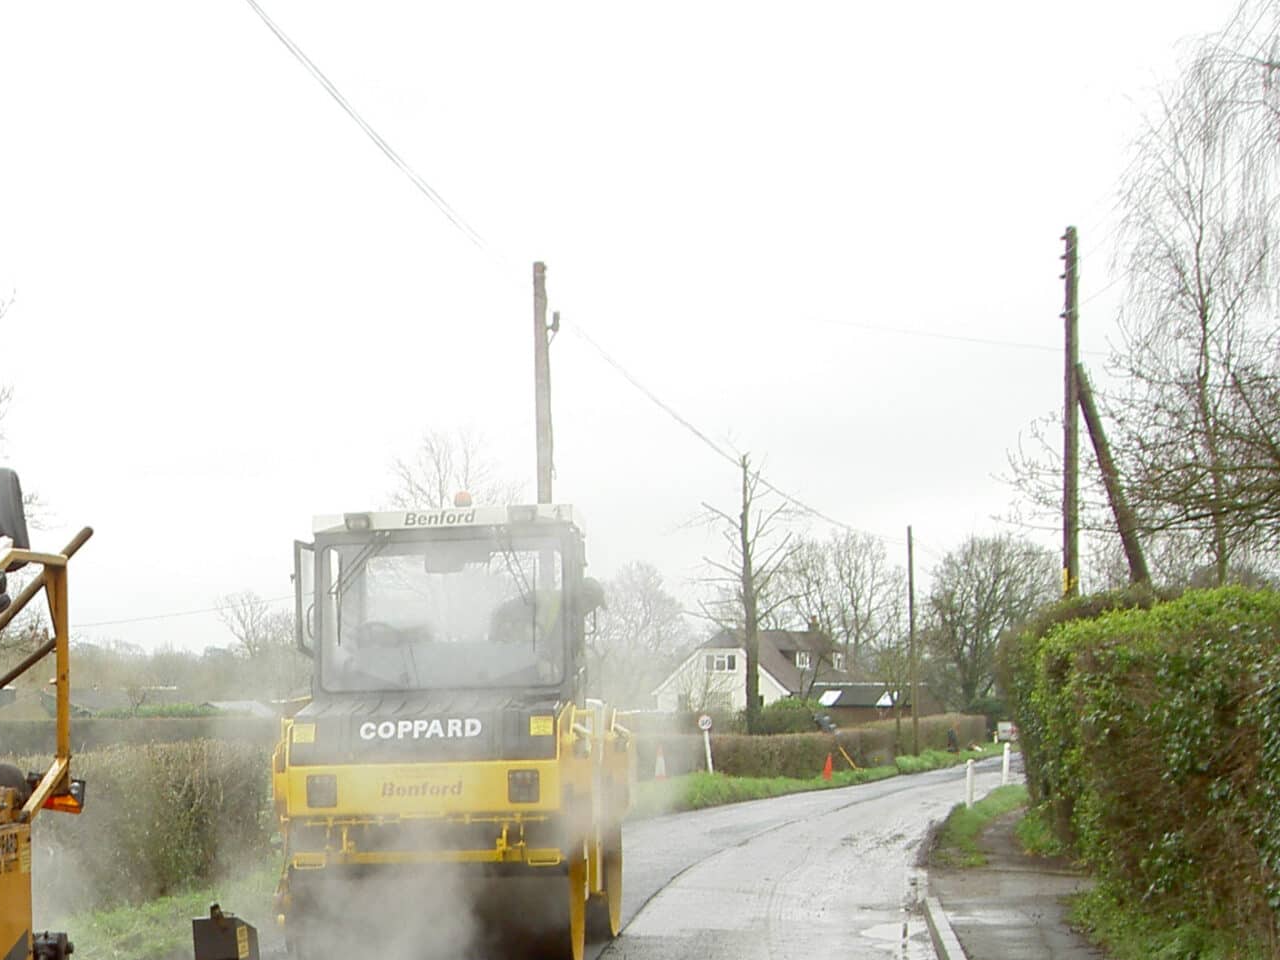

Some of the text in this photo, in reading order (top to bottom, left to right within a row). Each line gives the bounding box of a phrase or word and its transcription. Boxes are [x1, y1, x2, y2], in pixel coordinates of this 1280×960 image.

[404, 509, 476, 526] Benford
[359, 718, 482, 740] COPPARD
[381, 781, 464, 798] Benford
